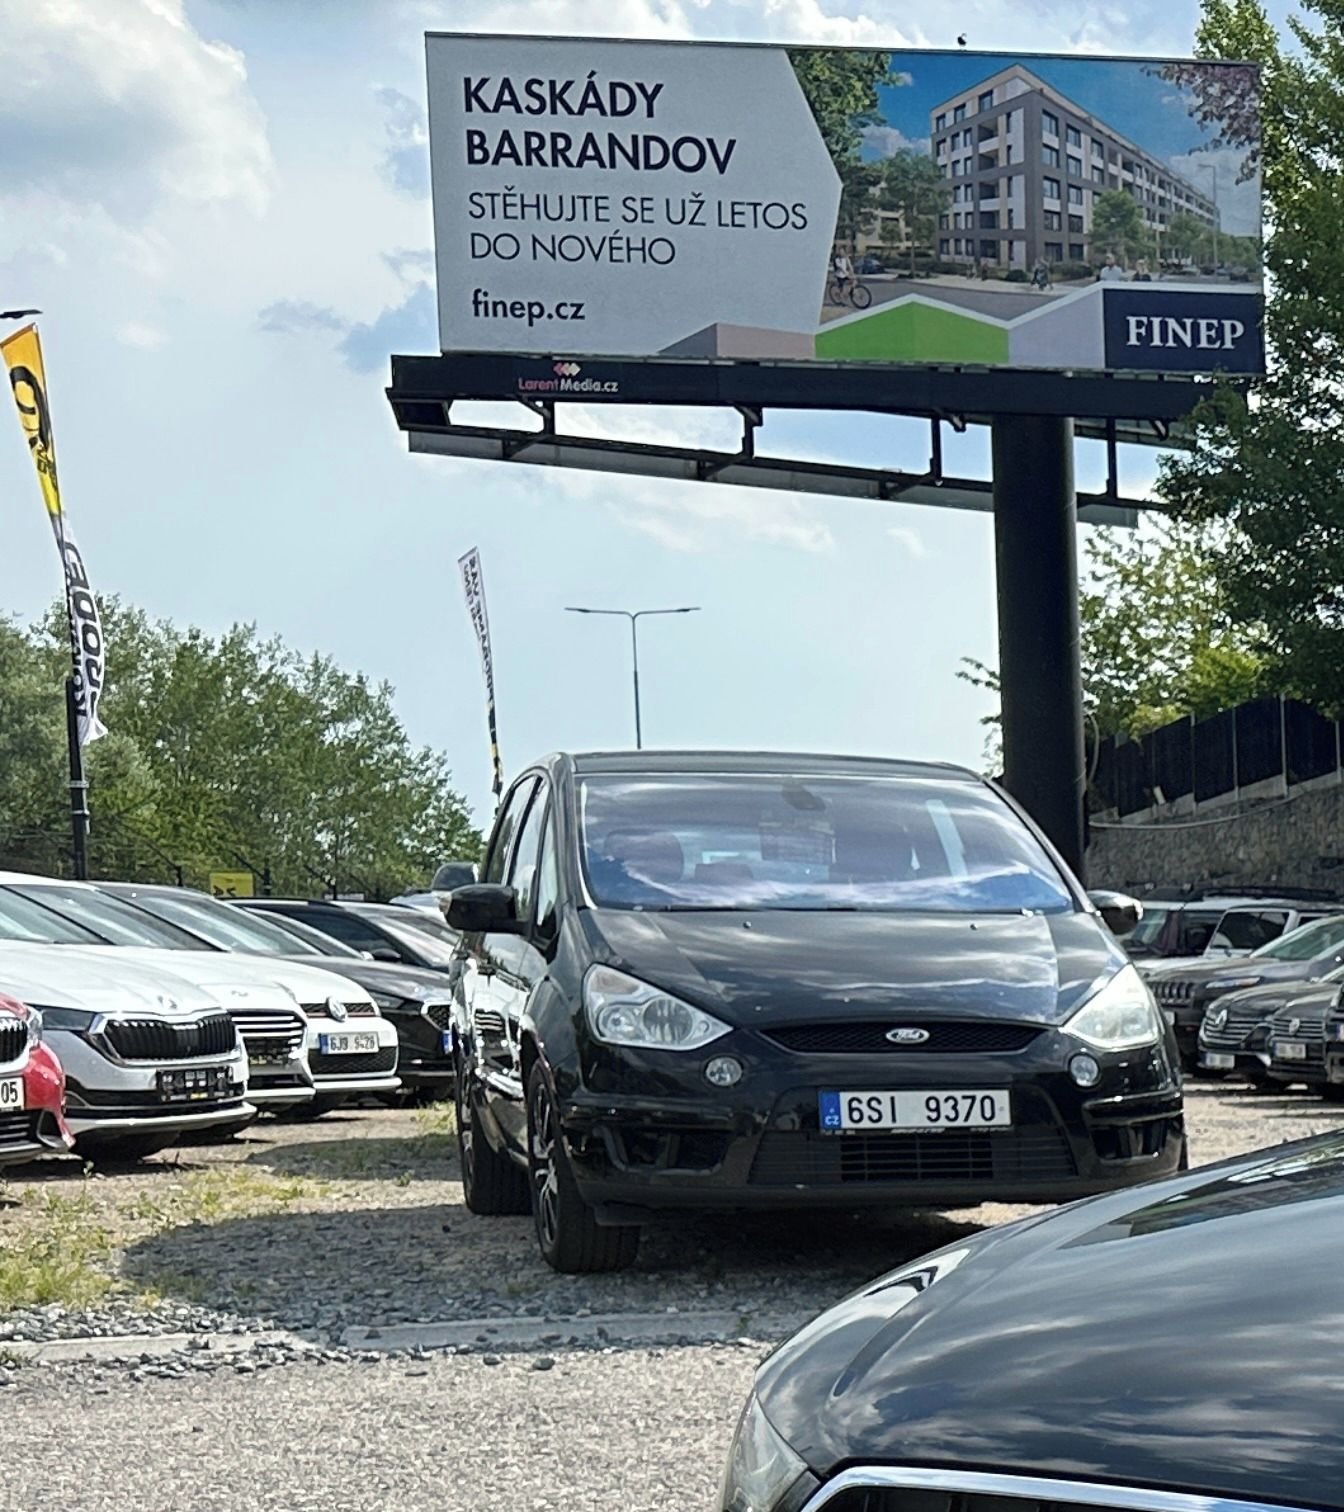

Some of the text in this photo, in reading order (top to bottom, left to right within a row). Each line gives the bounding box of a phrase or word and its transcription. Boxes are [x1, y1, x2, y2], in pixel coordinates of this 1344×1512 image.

[464, 70, 664, 118] KASKÁDY
[466, 129, 736, 175] BARRANDOV
[468, 185, 808, 230] STĚHUJTE SE UŽ LETOS
[470, 229, 676, 265] DO NOVÉHO
[472, 288, 586, 327] finep.cz
[1126, 315, 1246, 350] FINEP
[825, 1115, 839, 1126] CZ
[925, 1095, 996, 1123] 9370
